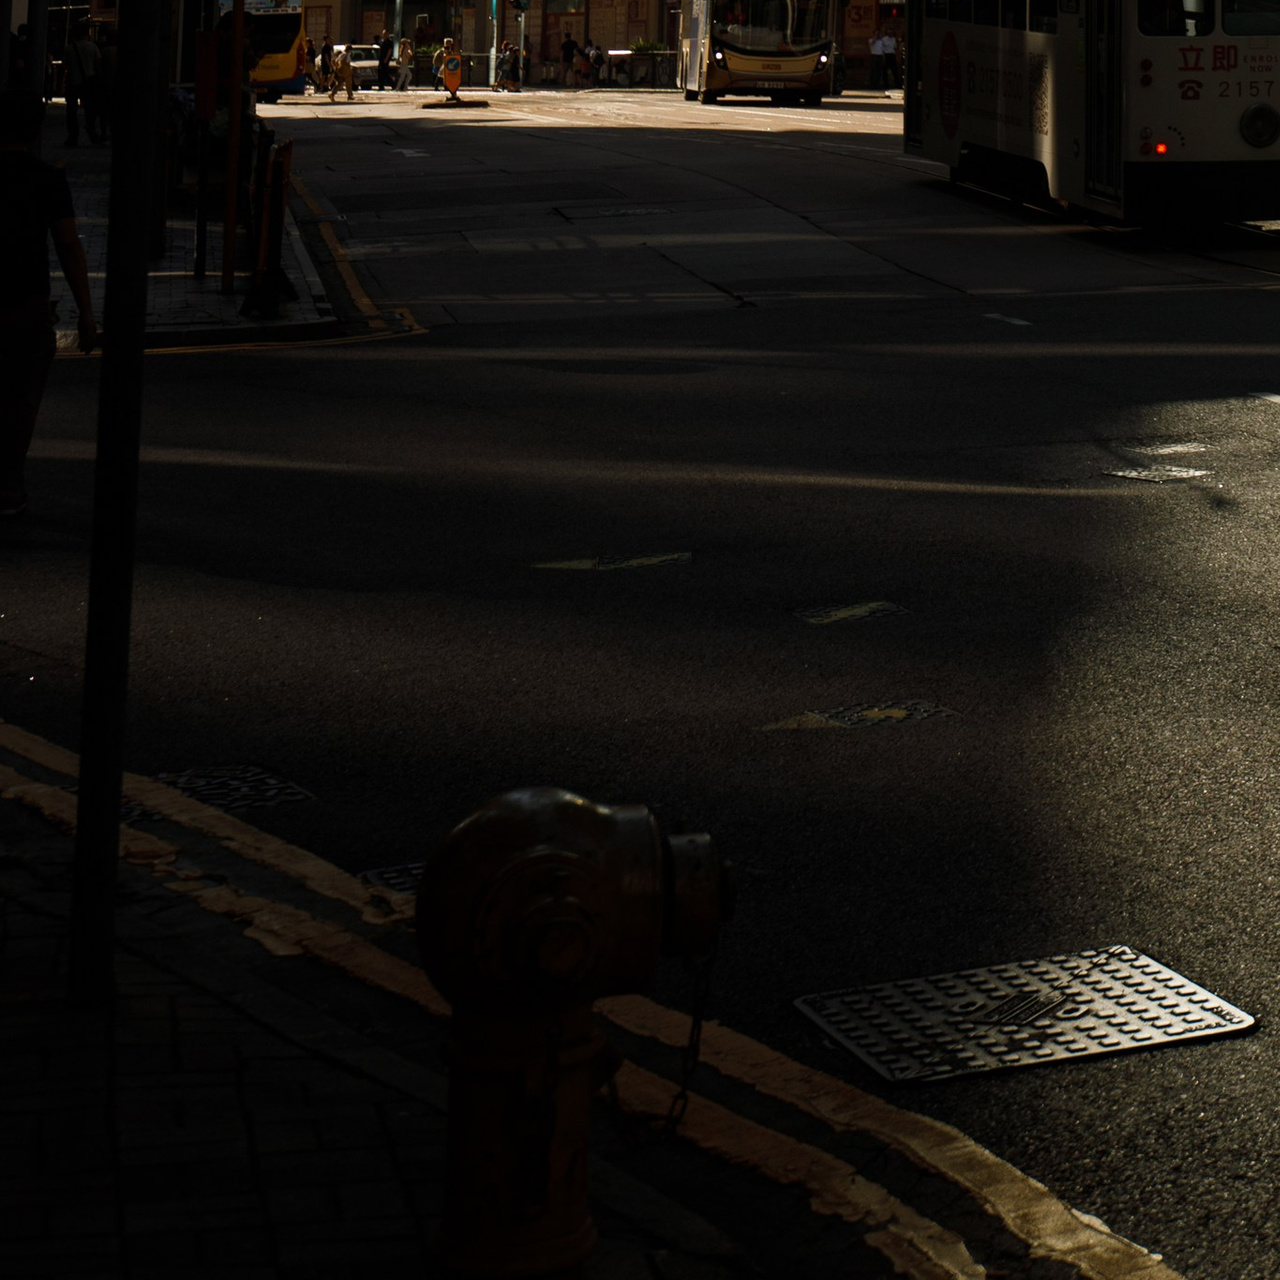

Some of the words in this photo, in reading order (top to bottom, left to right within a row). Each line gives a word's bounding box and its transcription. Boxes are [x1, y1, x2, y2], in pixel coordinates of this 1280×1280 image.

[1178, 45, 1239, 71] 立即
[1243, 55, 1279, 64] ENROL
[1218, 81, 1275, 97] 2157
